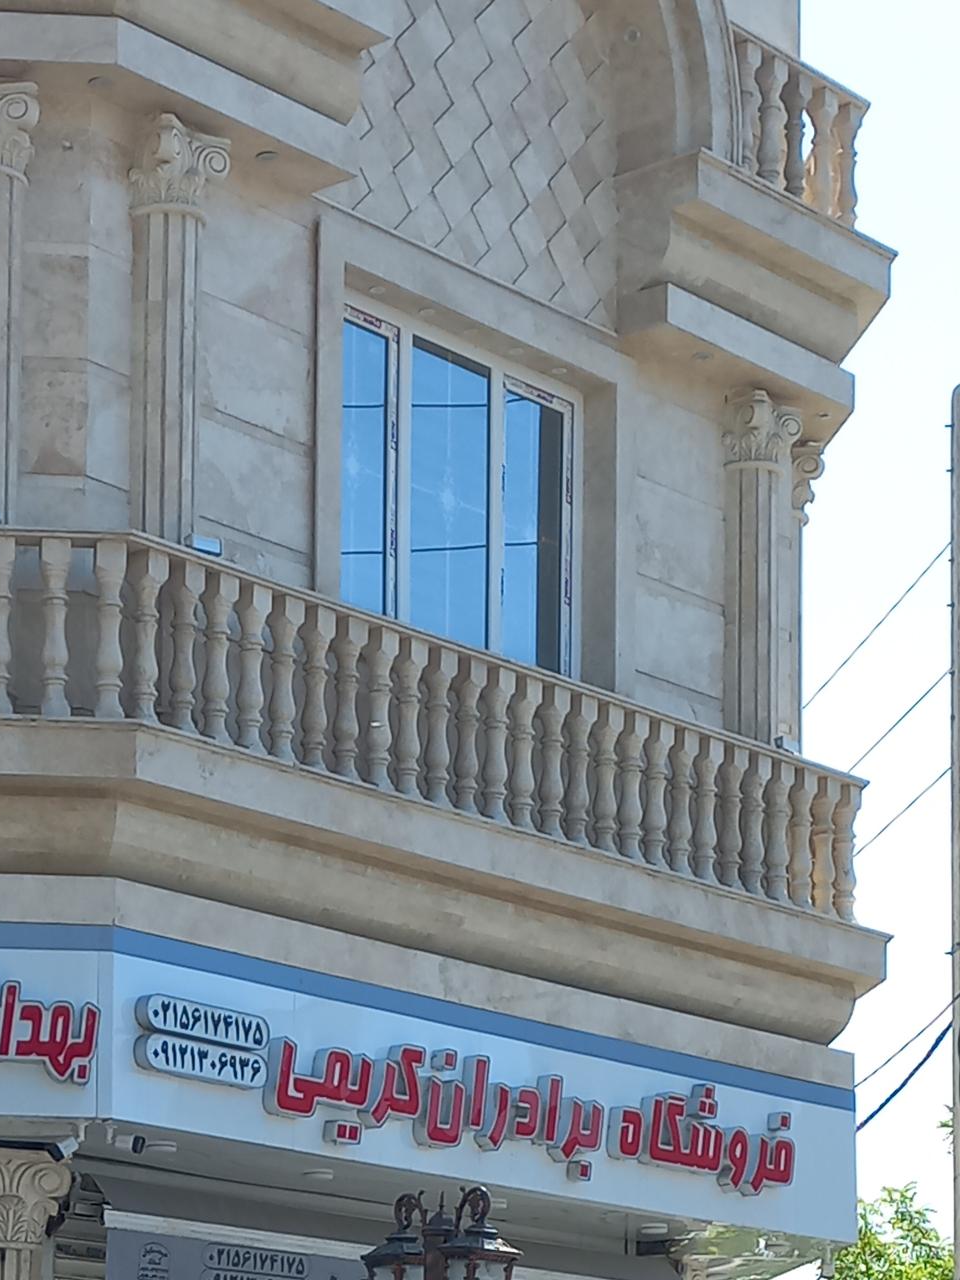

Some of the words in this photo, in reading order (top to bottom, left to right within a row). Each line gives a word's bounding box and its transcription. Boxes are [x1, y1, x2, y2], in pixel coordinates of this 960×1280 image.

[275, 1038, 426, 1143] کریمی
[426, 1049, 604, 1182] برادران
[618, 1084, 796, 1196] فروشگاه
